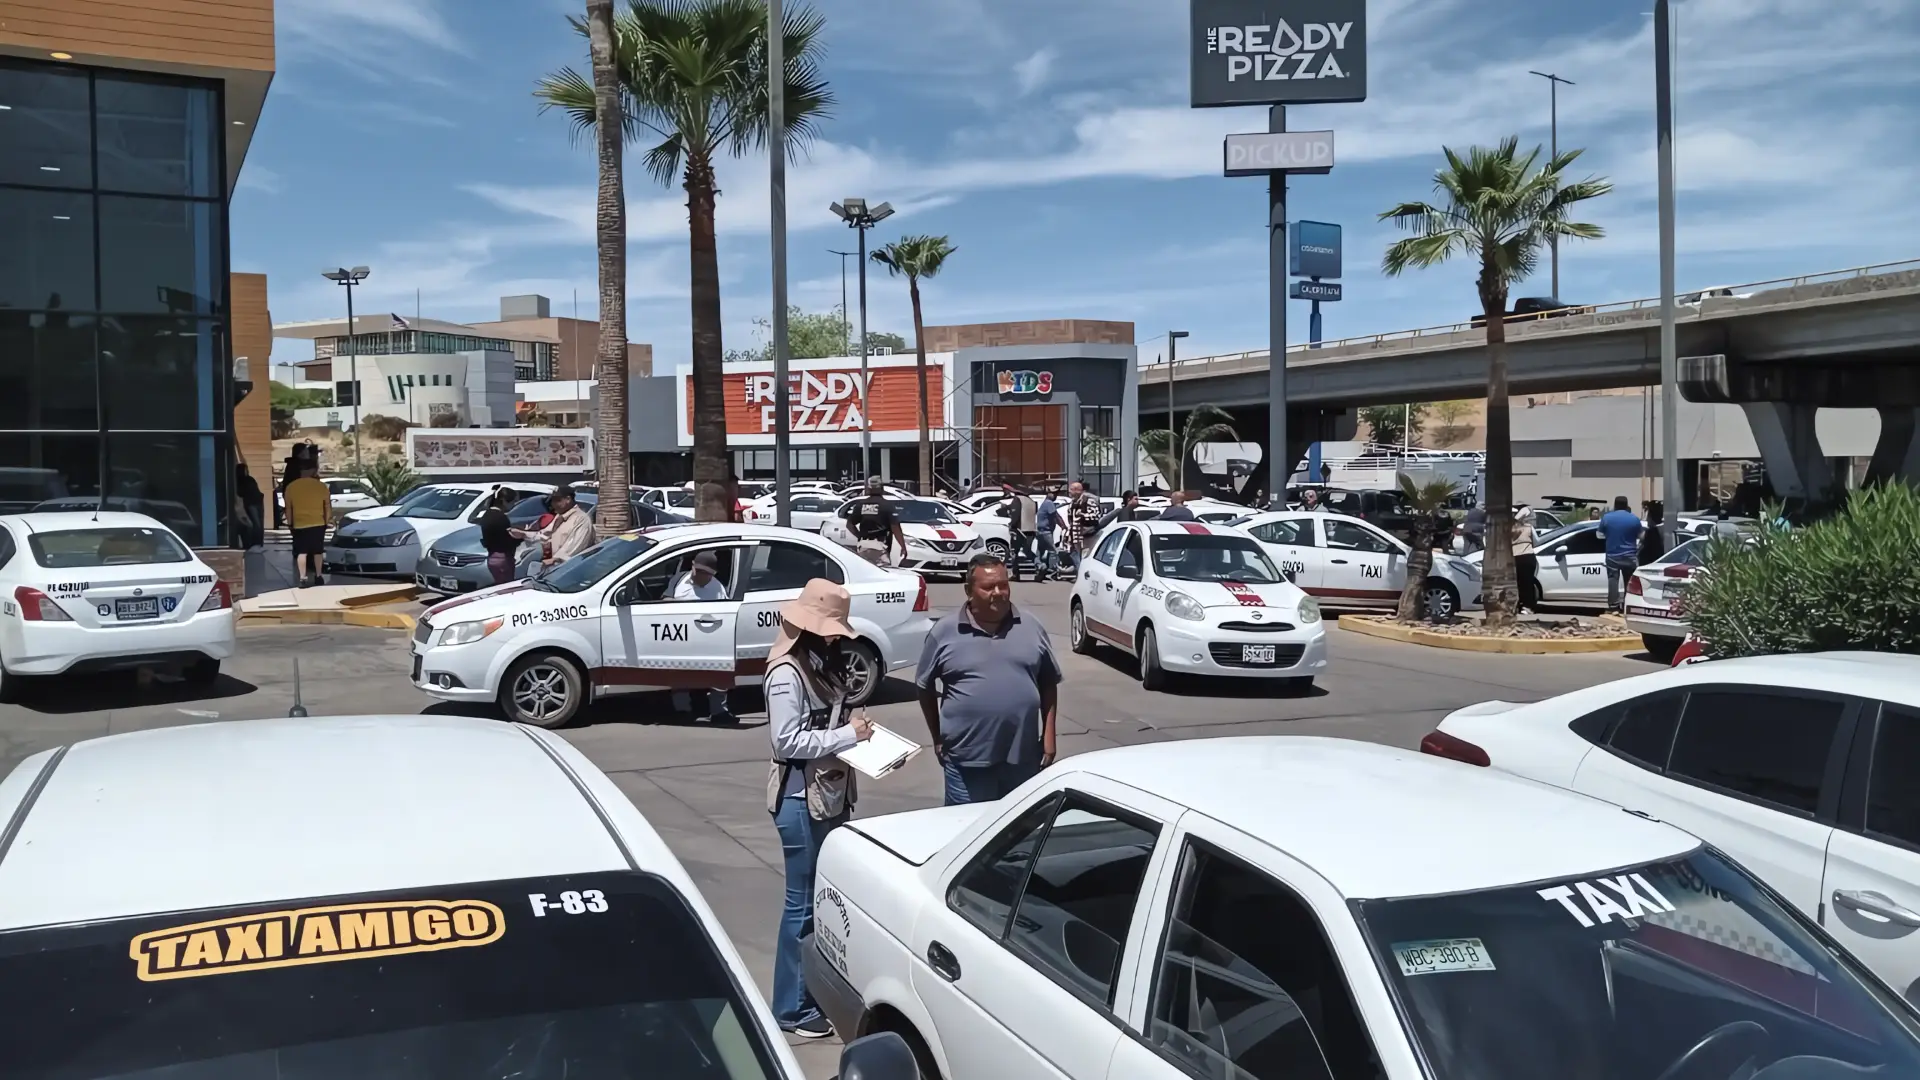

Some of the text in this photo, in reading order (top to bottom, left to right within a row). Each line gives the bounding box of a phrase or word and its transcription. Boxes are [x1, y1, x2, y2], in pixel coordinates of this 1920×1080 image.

[1207, 17, 1354, 56] THE READY
[1228, 52, 1345, 82] PIZZA
[1230, 142, 1331, 166] PICKUP
[997, 370, 1053, 394] KIDS
[1360, 564, 1382, 579] TAXI
[1581, 566, 1600, 575] TAXI
[757, 611, 784, 628] SON
[651, 623, 688, 642] TAXI
[528, 889, 610, 917] F-83
[1536, 873, 1677, 928] TAXI
[148, 908, 490, 970] TAXI AMIGO
[1401, 945, 1480, 967] WBC-380-B
